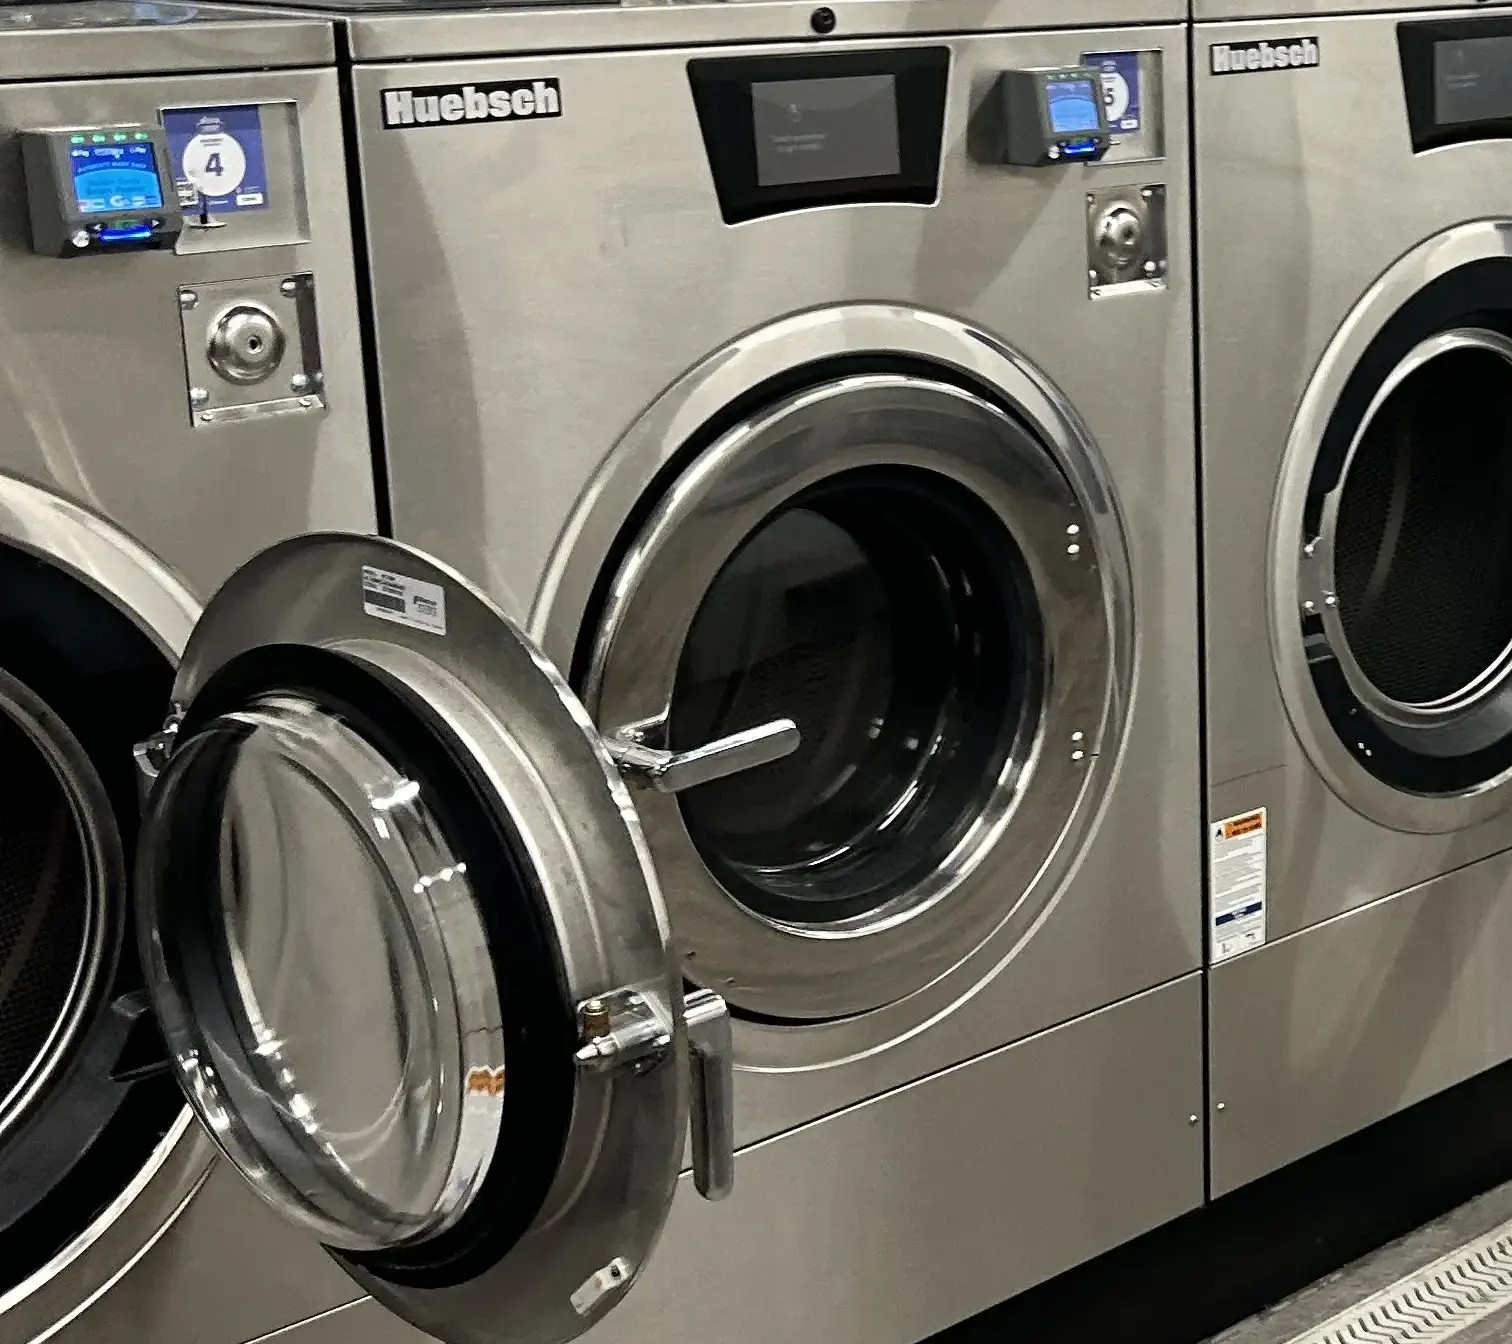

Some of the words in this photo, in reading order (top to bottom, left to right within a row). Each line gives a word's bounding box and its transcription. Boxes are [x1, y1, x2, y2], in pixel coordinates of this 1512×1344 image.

[1212, 39, 1317, 72] Huebsch
[384, 81, 559, 125] Huebsch
[205, 153, 223, 176] 4
